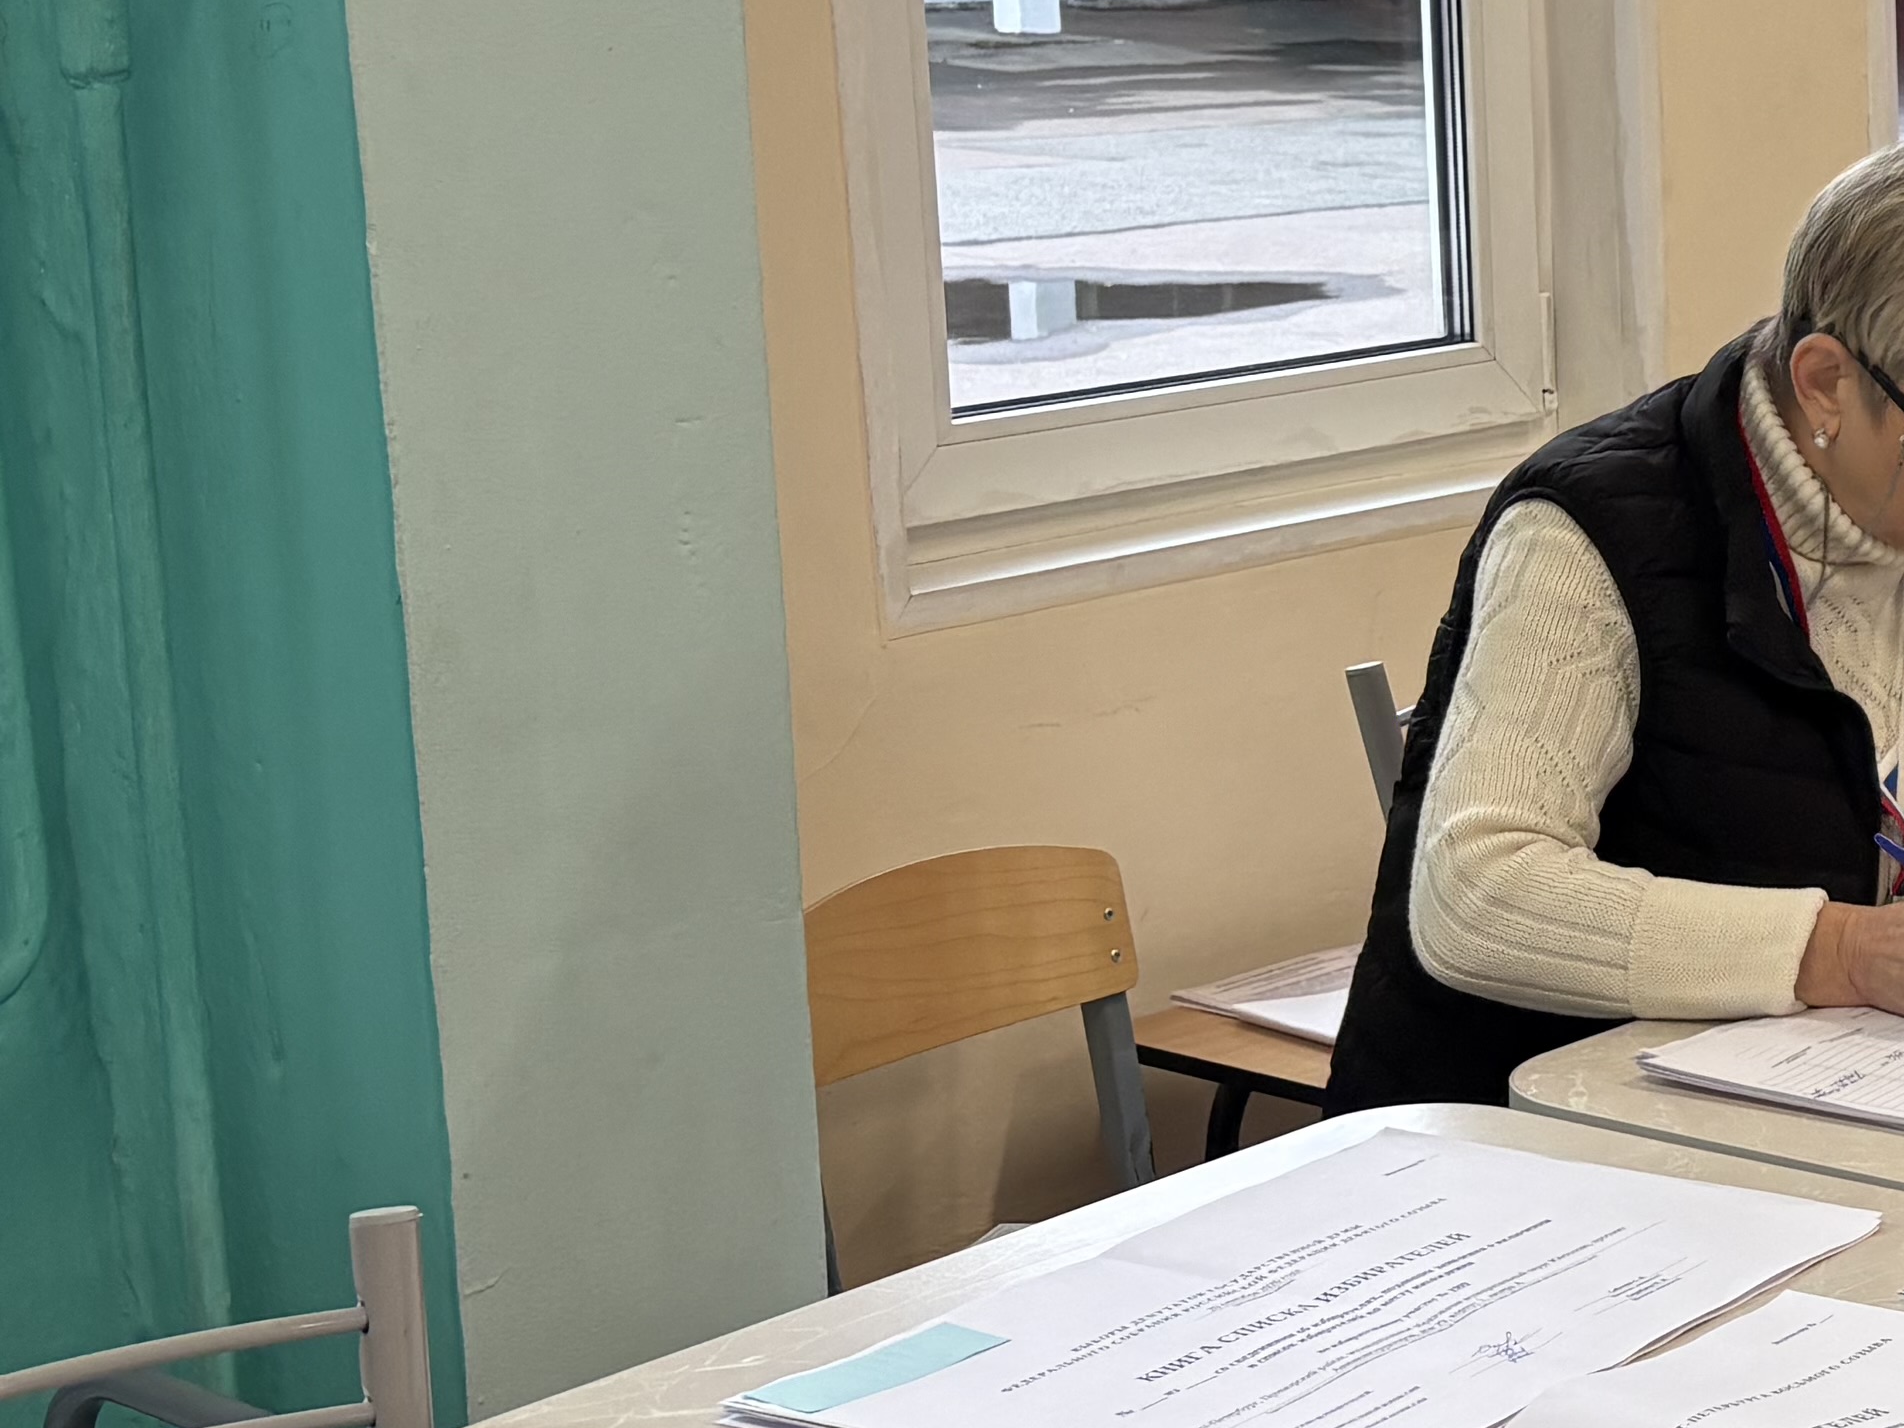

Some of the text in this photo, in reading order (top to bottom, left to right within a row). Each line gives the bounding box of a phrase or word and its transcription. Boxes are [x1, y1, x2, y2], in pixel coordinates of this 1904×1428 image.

[1135, 1232, 1471, 1382] КНИГА СПИСКА ИЗБИРАТЕЛЕЙ
